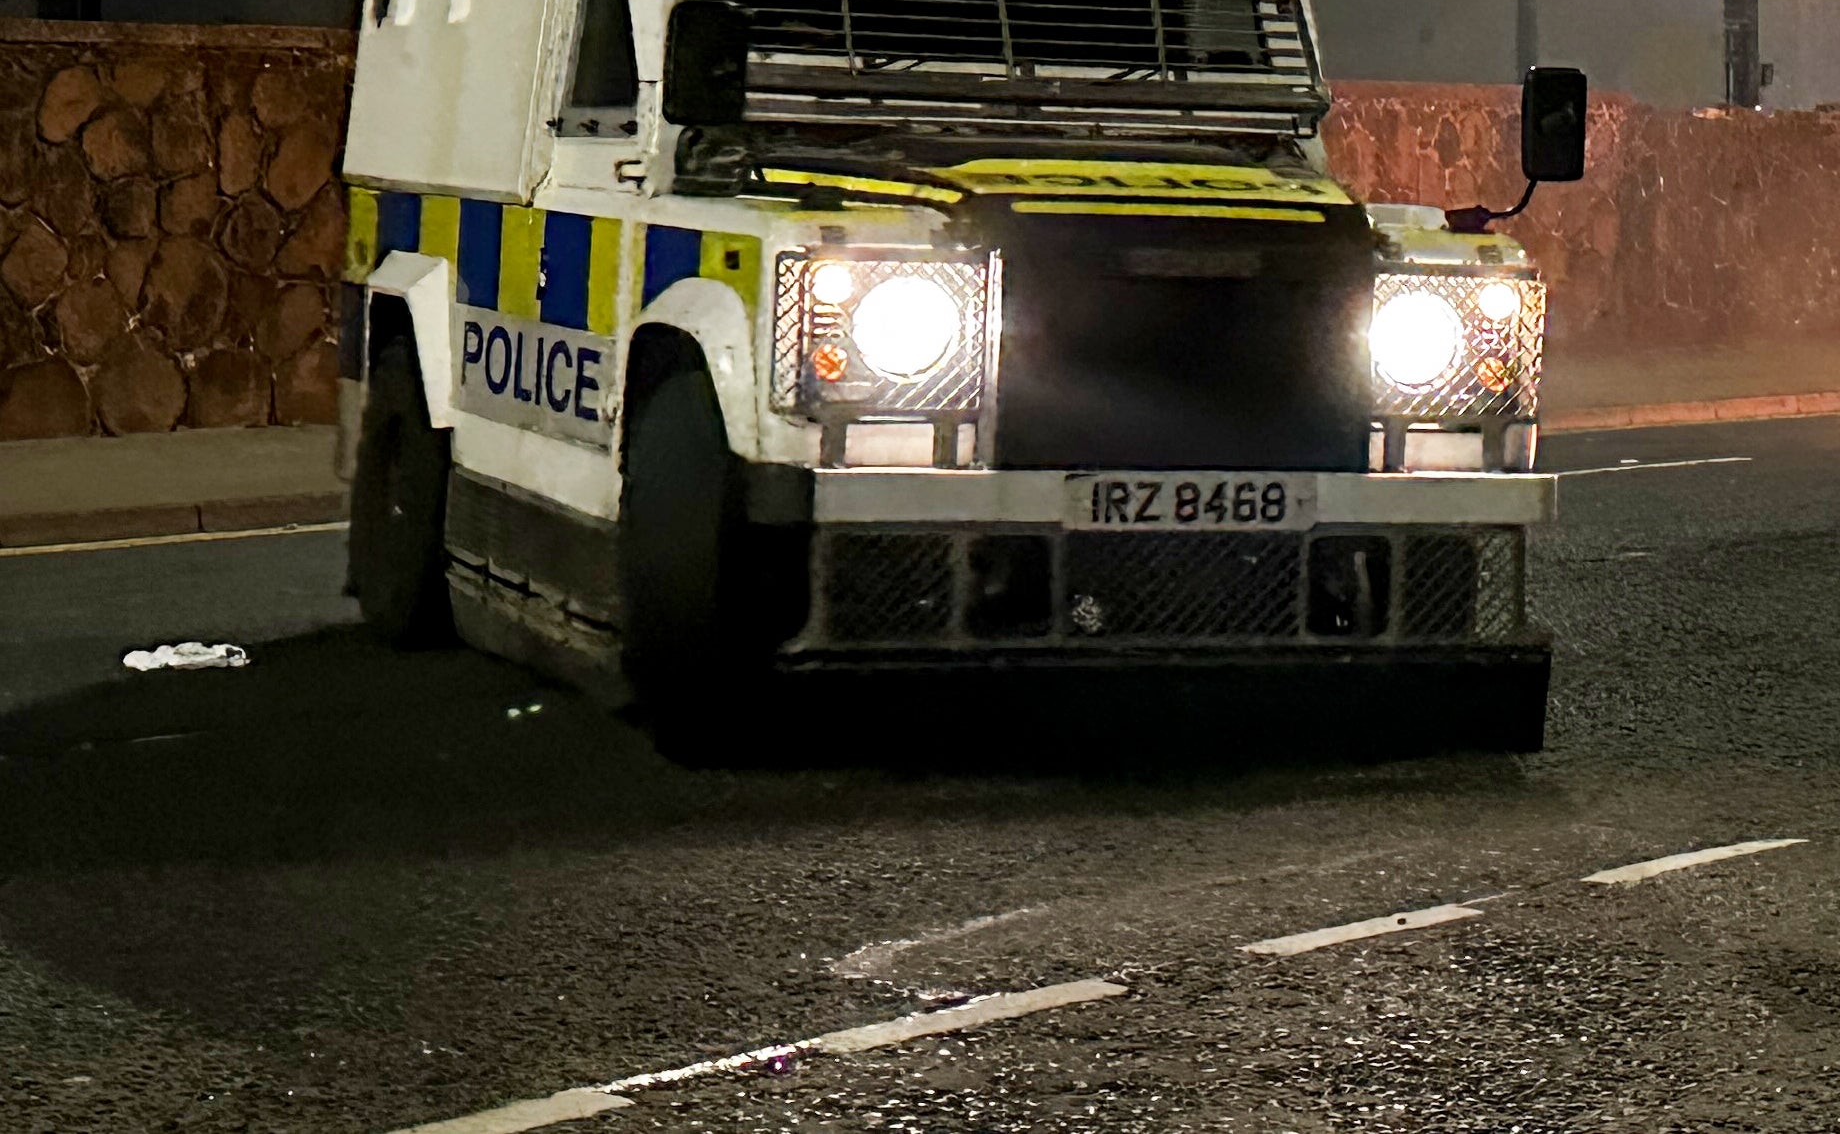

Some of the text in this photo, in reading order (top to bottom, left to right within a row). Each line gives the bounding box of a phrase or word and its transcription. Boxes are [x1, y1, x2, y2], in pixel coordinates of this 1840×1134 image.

[461, 321, 602, 422] POLICE
[1091, 481, 1287, 524] IRZ 8468
